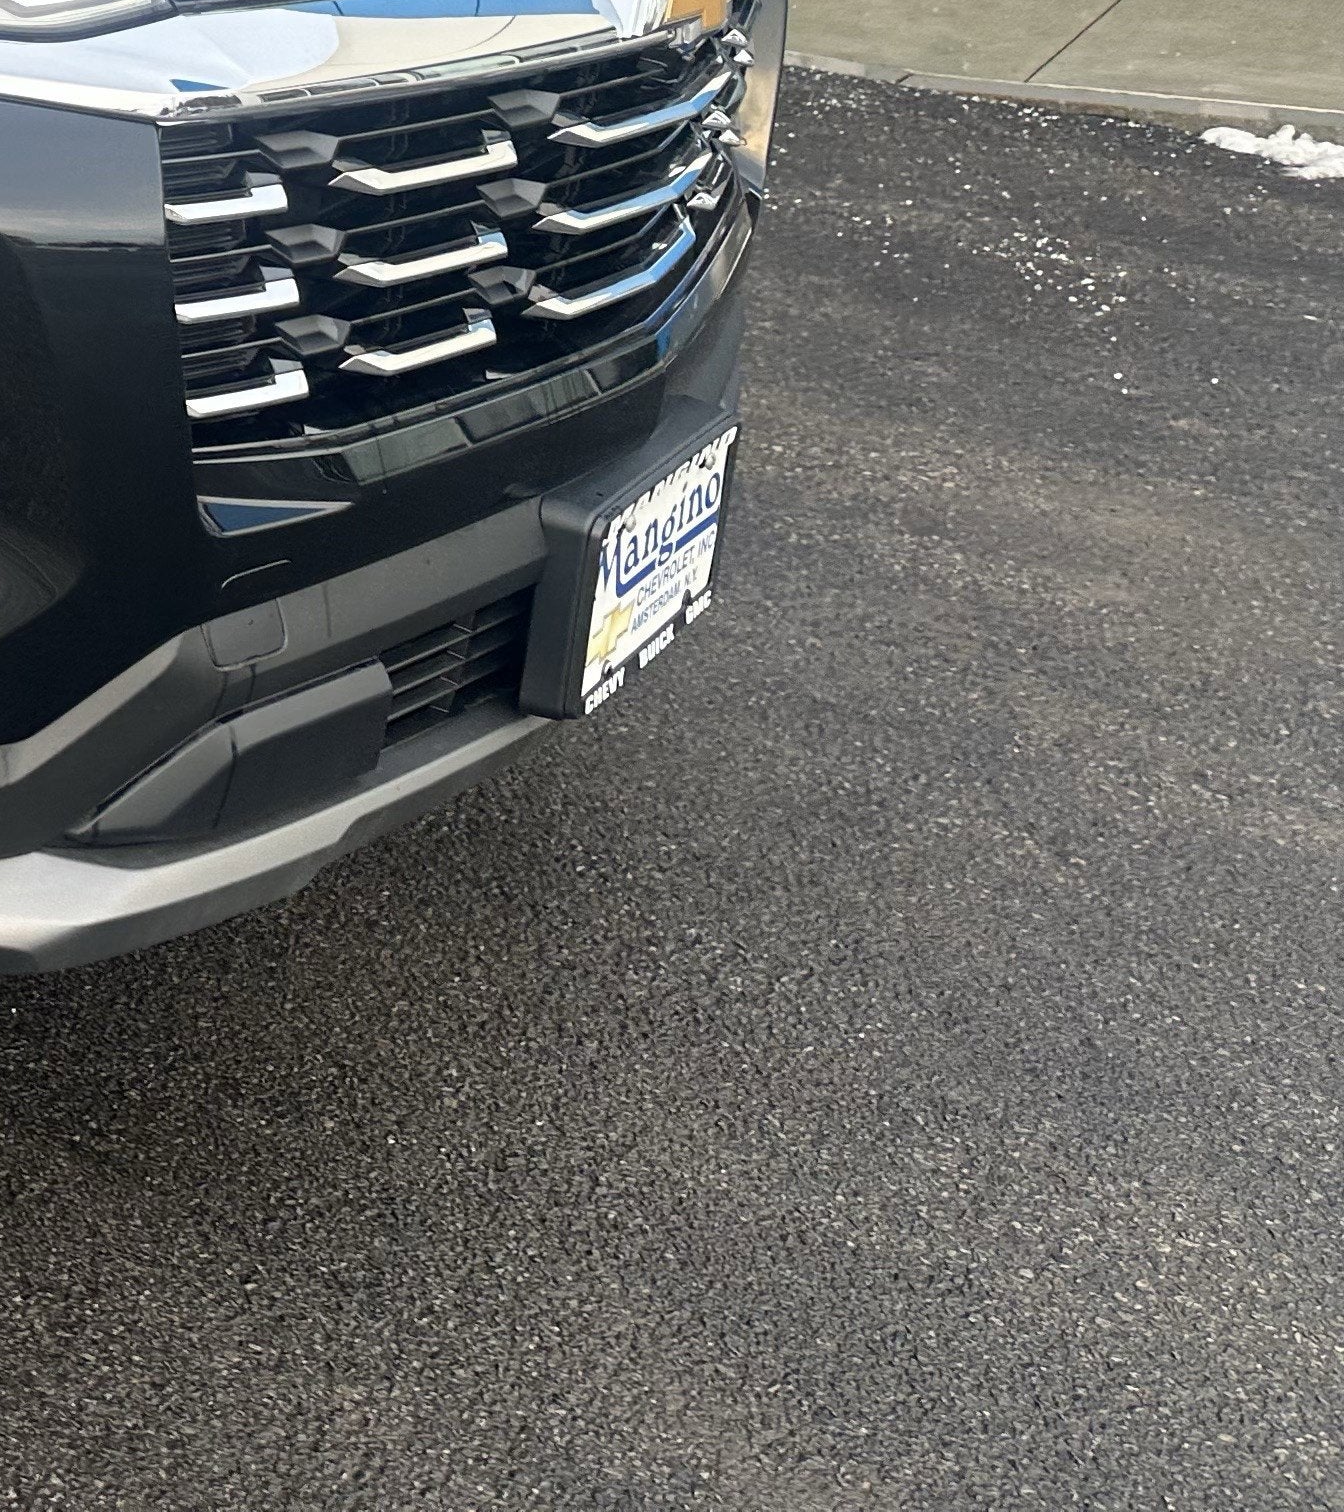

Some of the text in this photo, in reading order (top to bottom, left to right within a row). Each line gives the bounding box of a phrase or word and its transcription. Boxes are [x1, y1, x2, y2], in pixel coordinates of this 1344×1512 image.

[599, 472, 722, 597] Mangino
[585, 590, 712, 715] CHEVY BUICK GMC
